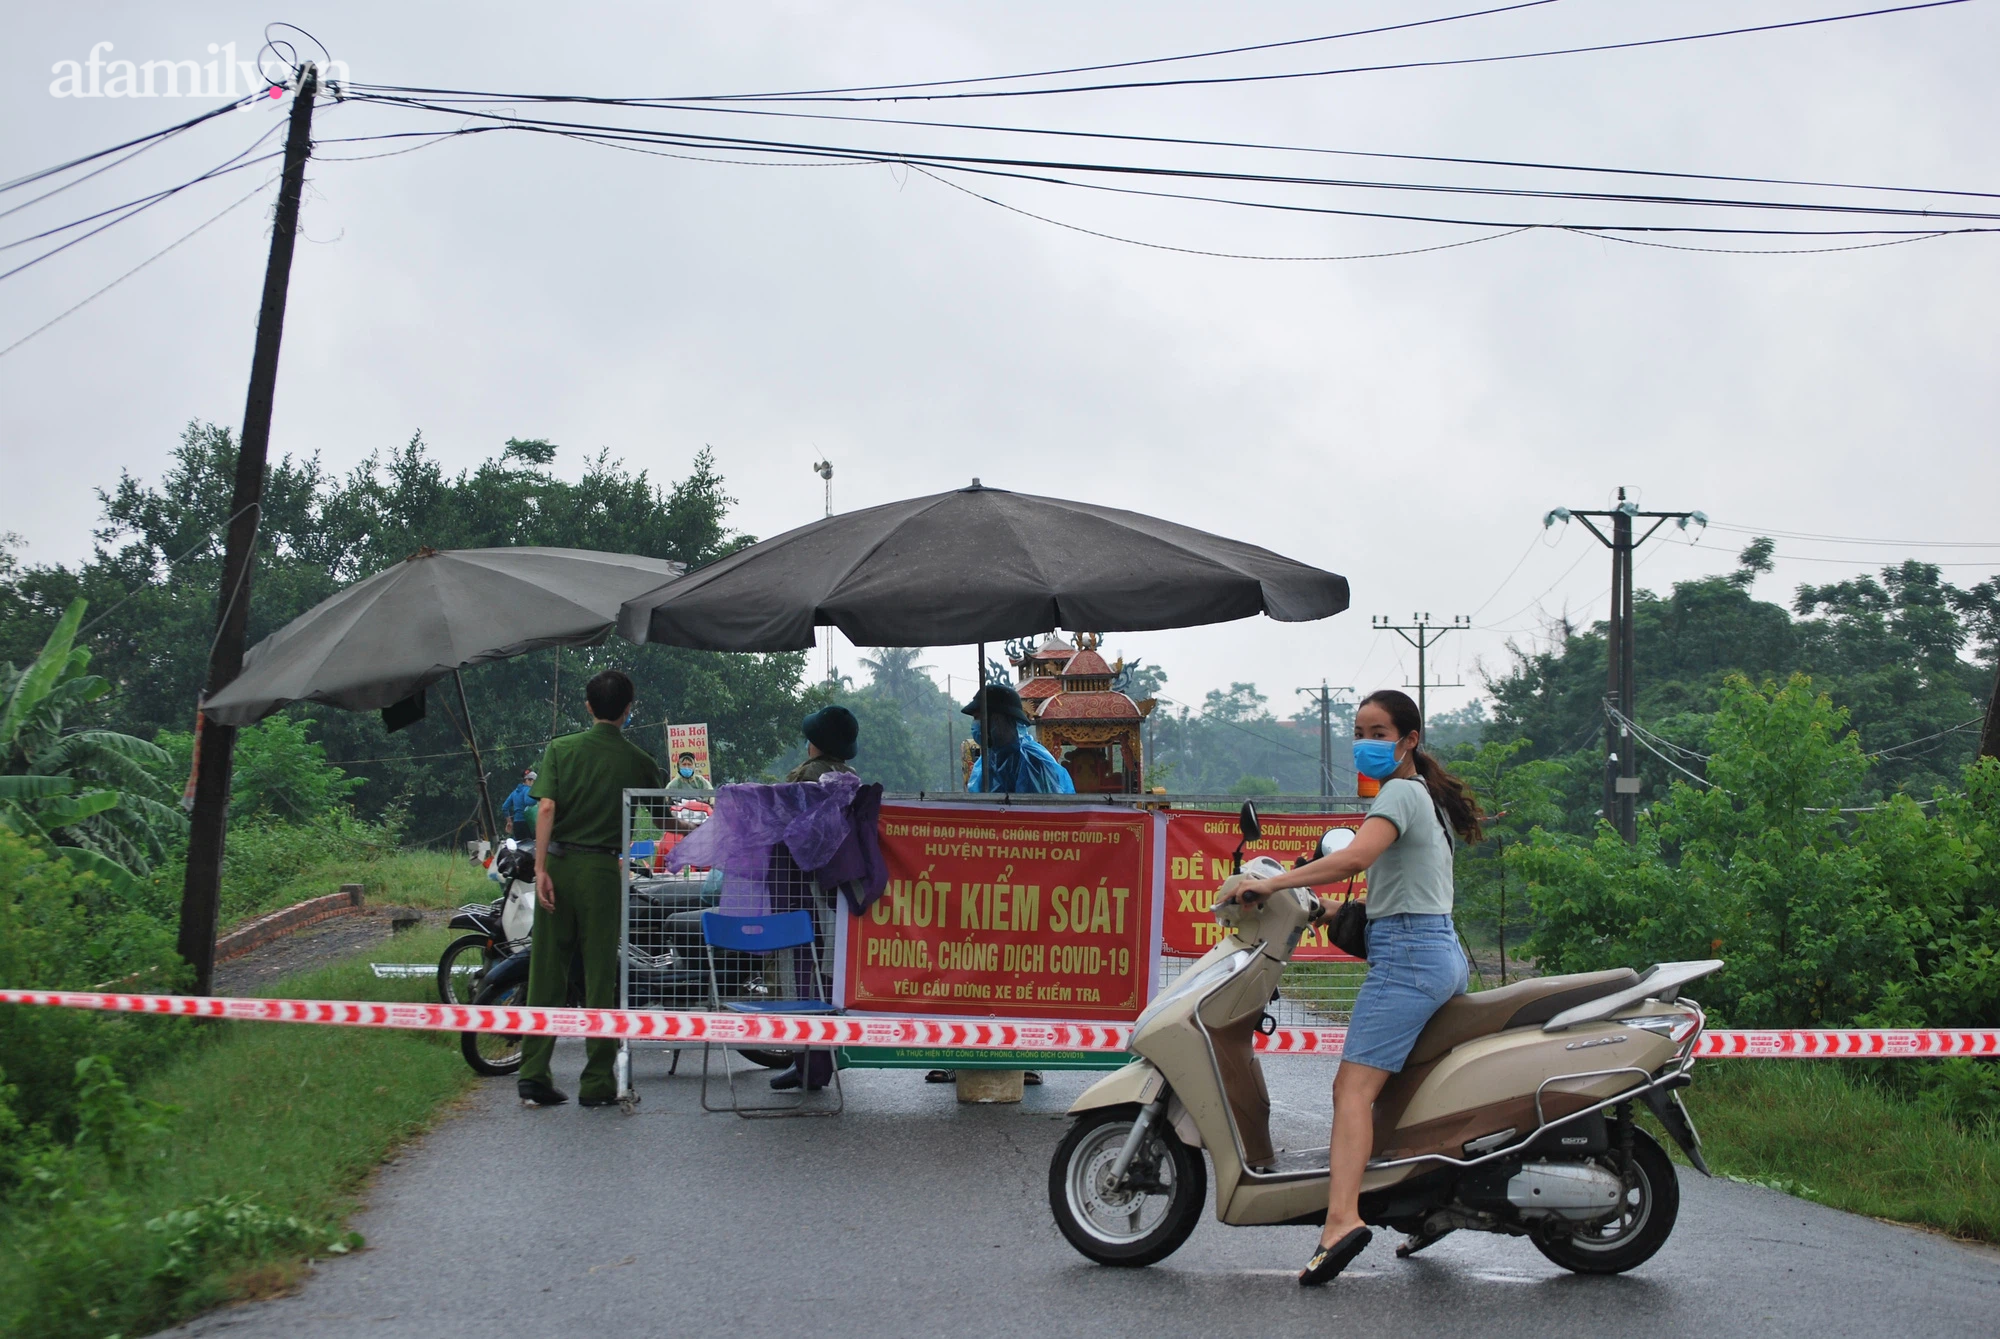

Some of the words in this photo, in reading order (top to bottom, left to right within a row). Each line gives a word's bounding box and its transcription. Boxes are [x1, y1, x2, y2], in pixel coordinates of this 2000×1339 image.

[670, 727, 686, 737] Bia
[672, 738, 685, 748] Hà
[688, 738, 706, 750] Nội
[886, 824, 909, 836] BAN
[912, 822, 931, 838] CHỈ
[933, 826, 956, 841] ĐẠO
[958, 825, 1000, 841] PHÒNG,
[1002, 826, 1040, 842] CHỐNG
[1043, 830, 1069, 845] DỊCH
[1072, 831, 1120, 844] COVID-19
[1204, 819, 1230, 834] CHỐT
[1260, 823, 1287, 836] SOÁT
[1289, 823, 1323, 837] PHÒNG
[925, 843, 983, 861] HUYỆN
[986, 846, 1047, 860] THANH
[1050, 848, 1081, 862] OAI
[1272, 840, 1318, 852] COVID-19
[1171, 850, 1204, 880] ĐỀ
[871, 864, 951, 928] CHỐT
[960, 864, 1040, 932] KIỂM
[1050, 876, 1130, 935] SOÁT
[866, 932, 932, 972] PHÒNG,
[938, 932, 998, 972] CHỐNG
[1003, 944, 1044, 978] DỊCH
[1050, 944, 1130, 976] COVID-19
[894, 980, 920, 996] YÊU
[922, 978, 950, 998] CẦU
[954, 980, 991, 999] DỪNG
[994, 985, 1012, 1000] XE
[1016, 980, 1035, 1001] ĐỂ
[1037, 981, 1072, 1002] KIỂM
[1076, 987, 1101, 1002] TRA
